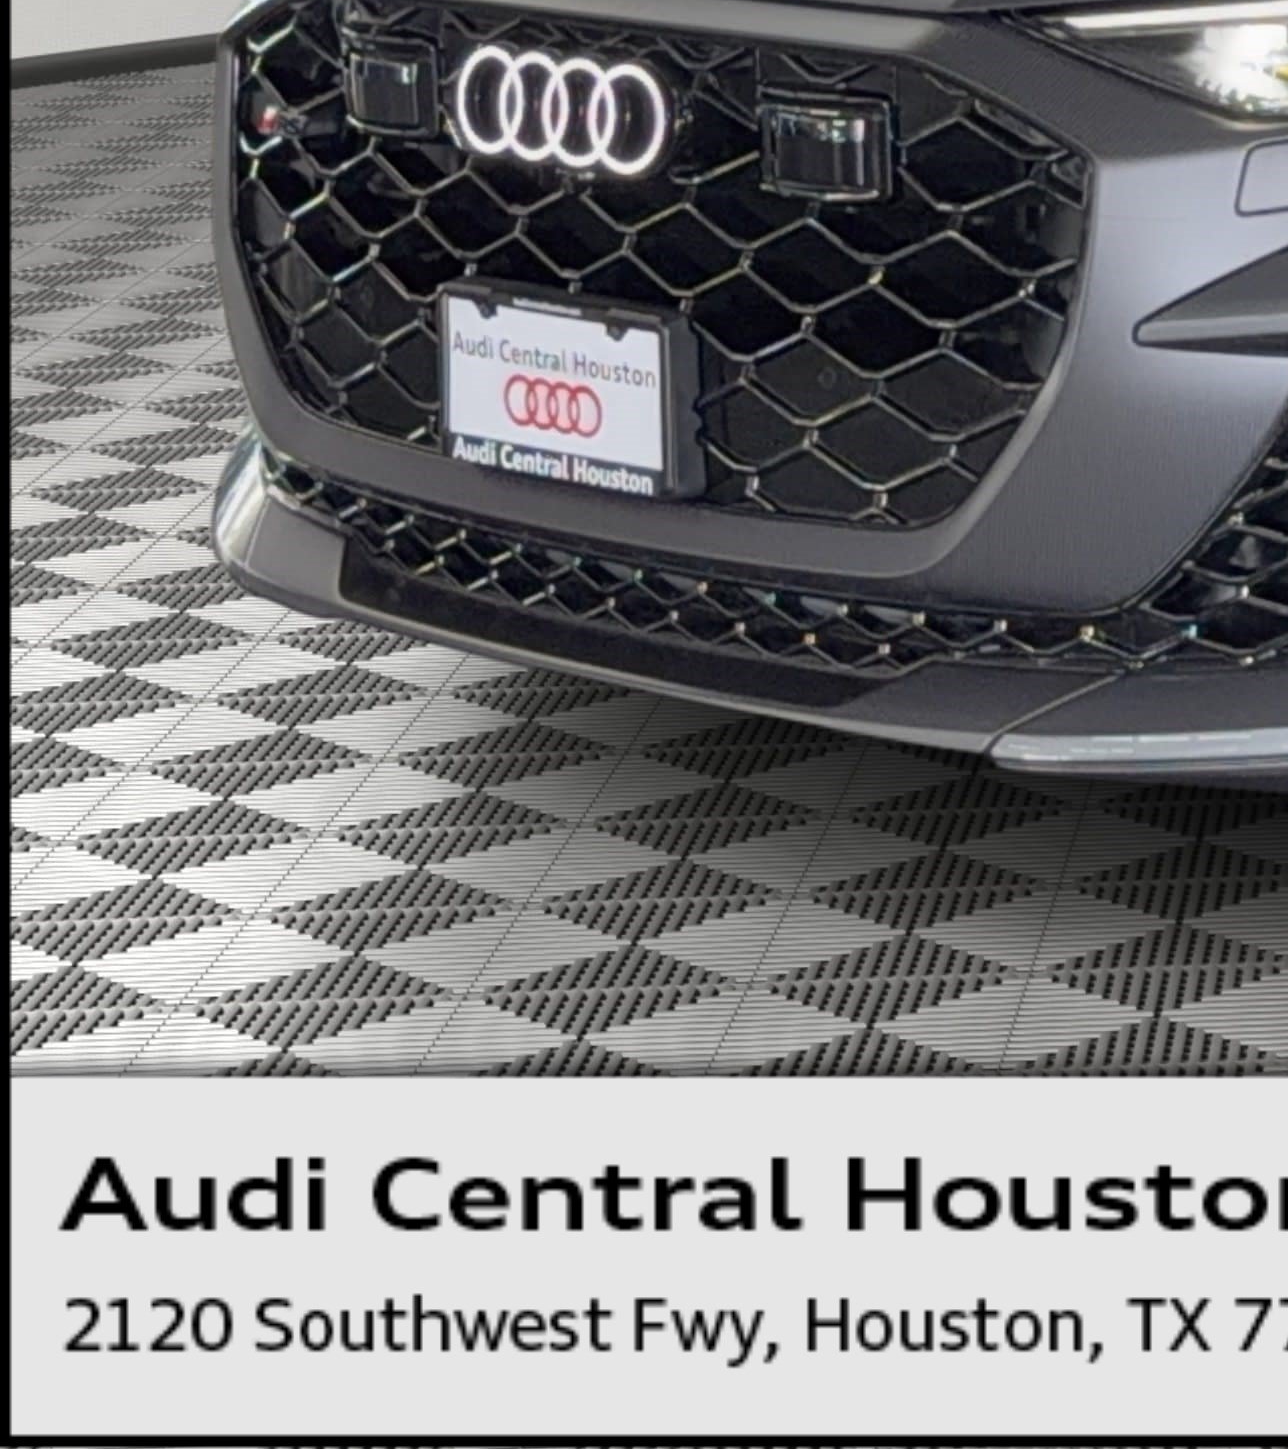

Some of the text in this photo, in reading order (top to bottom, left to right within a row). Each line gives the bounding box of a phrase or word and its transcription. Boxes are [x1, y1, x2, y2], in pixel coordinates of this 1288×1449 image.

[453, 331, 656, 389] Audi Central Houston
[452, 436, 654, 496] Audi Central Houston
